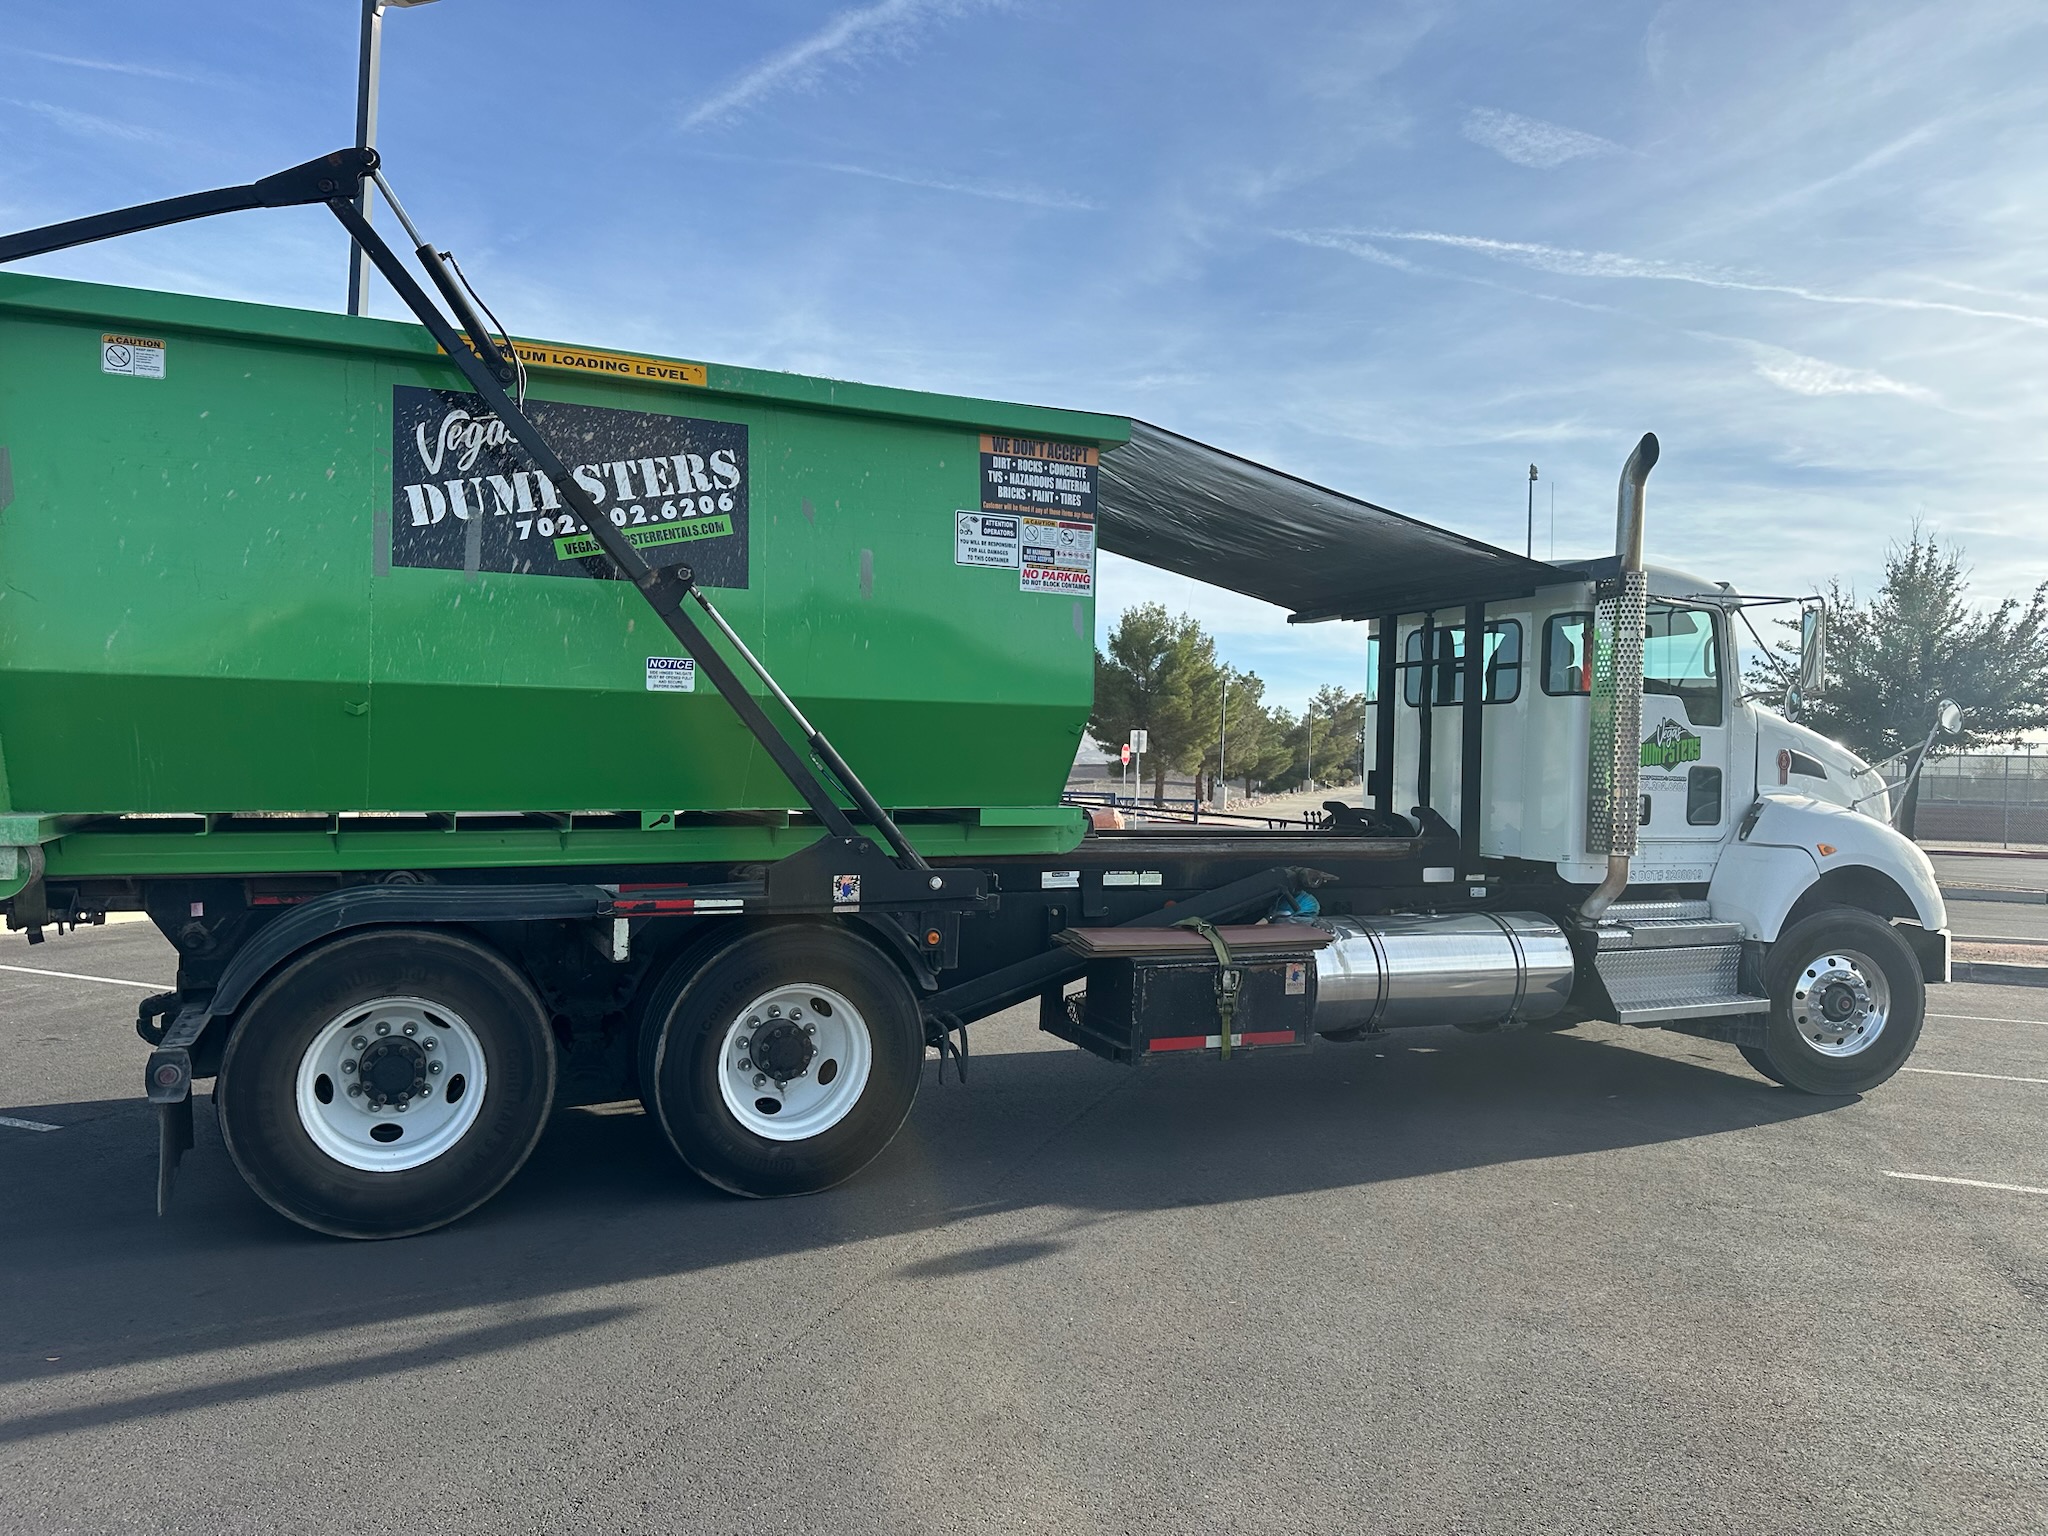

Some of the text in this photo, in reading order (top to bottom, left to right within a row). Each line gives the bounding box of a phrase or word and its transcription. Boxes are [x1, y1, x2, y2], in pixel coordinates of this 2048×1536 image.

[116, 337, 160, 348] CAUTION
[553, 354, 689, 381] LOADING LEVEL
[416, 410, 518, 475] Vega
[992, 436, 1089, 463] WE DON'T ACCEPT
[992, 456, 1087, 479] DIRT ROCKS CONCRETE
[988, 470, 1091, 494] TVS HAZARDOUS MATERIAL
[997, 486, 1082, 507] BRICKS PAINT TIRES
[983, 501, 1003, 510] Customer
[516, 492, 734, 541] 702.02.6206
[1030, 519, 1055, 527] CAUTION
[986, 520, 1013, 528] ATTENTION
[564, 520, 725, 555] VEGASSTERRENTALS.COM
[983, 528, 1015, 537] OPERATORS:
[988, 541, 1016, 549] RESPONSIBLE
[1022, 569, 1091, 584] NO PARKING
[1043, 580, 1060, 588] BLOCK
[649, 659, 693, 669] NOTICE
[1657, 717, 1687, 748] Vegas
[1640, 781, 1687, 792] 02.202.6206
[1639, 870, 1664, 881] DOT#
